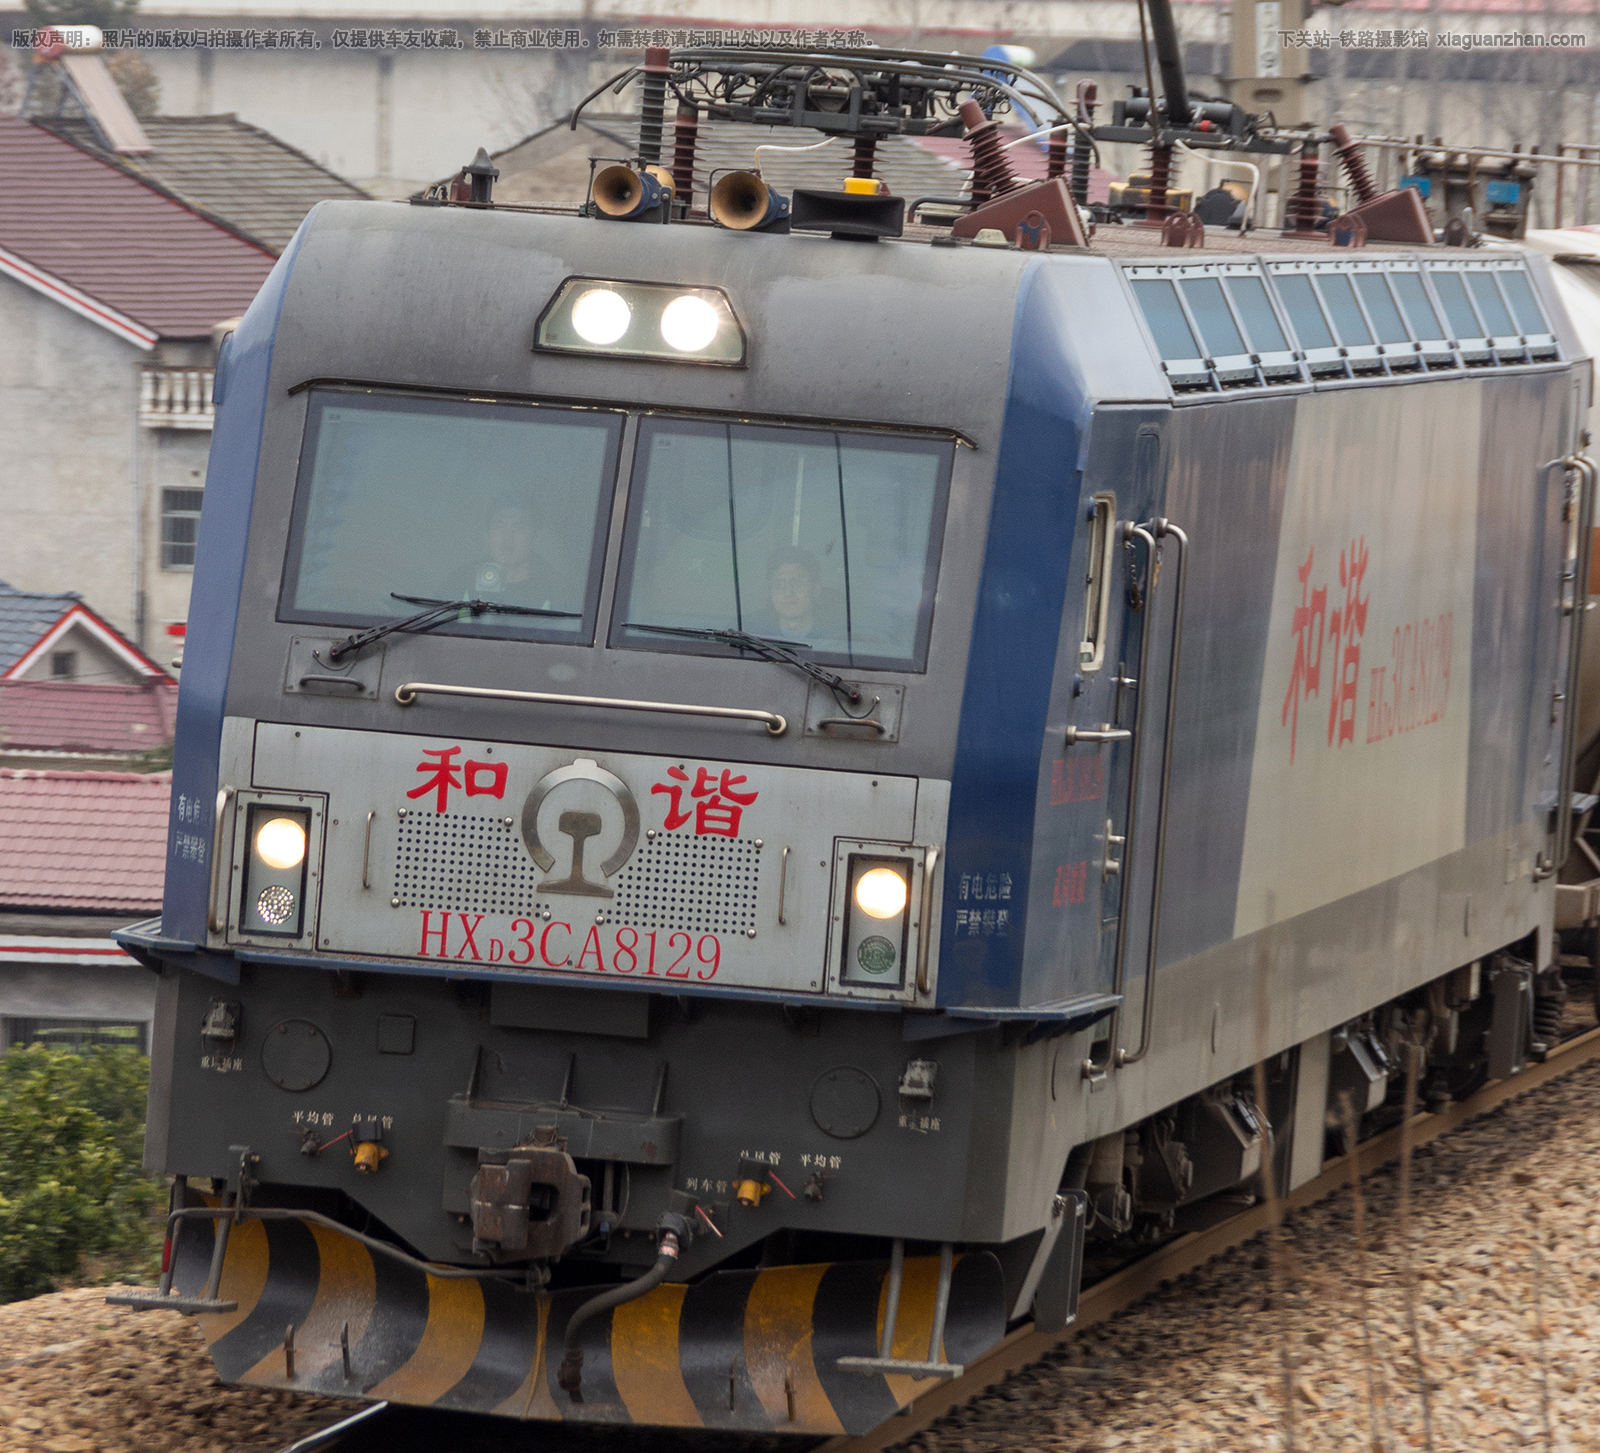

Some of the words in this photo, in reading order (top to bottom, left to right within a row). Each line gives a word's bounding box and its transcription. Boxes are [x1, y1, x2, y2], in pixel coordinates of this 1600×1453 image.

[1281, 534, 1369, 766] 和谐
[406, 746, 509, 814] 和
[651, 766, 759, 838] 谐
[959, 872, 1012, 900] 有电危险
[417, 909, 721, 980] HXD3CA8129
[293, 1110, 334, 1126] 平均管
[800, 1154, 842, 1169] 平均管
[686, 1178, 727, 1194] 列车管
